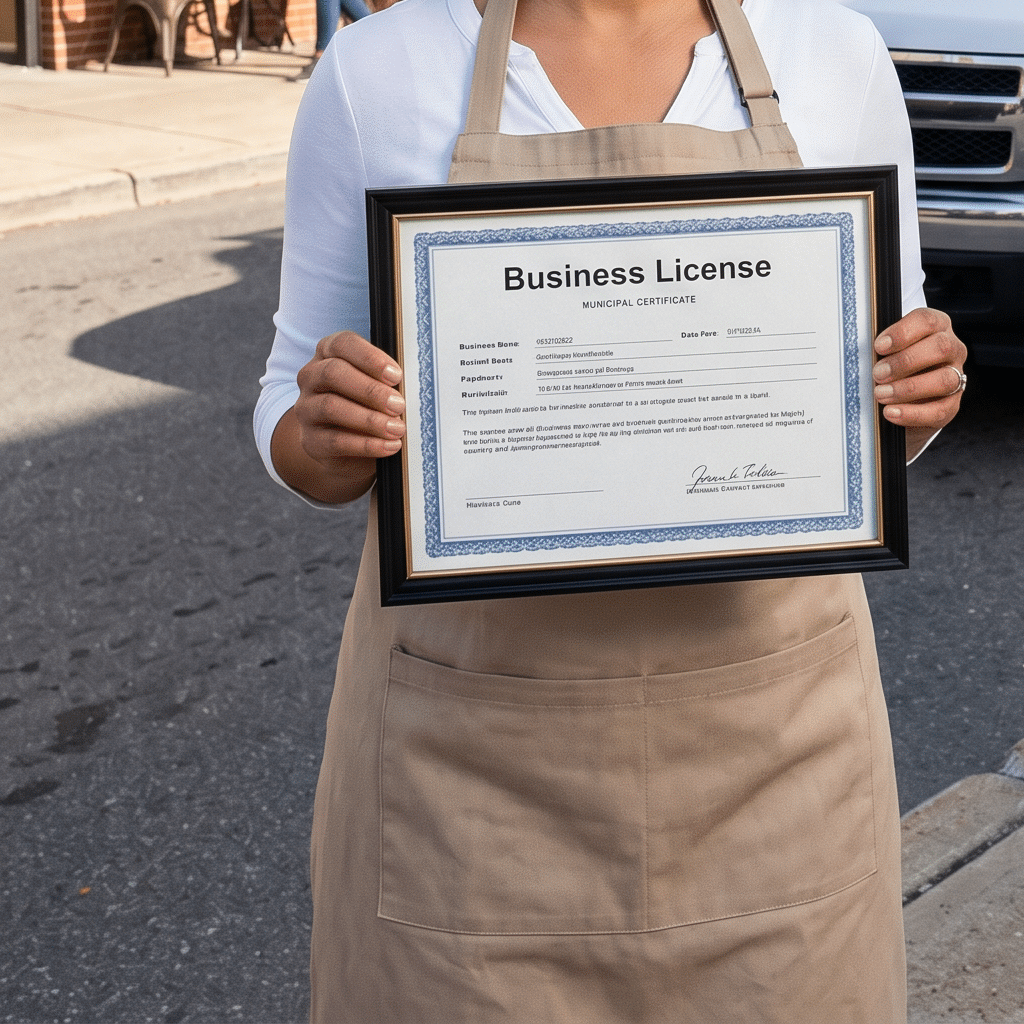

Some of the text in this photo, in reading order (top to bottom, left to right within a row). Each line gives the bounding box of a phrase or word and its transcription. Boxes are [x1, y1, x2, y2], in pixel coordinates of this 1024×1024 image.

[504, 258, 772, 291] Business License
[582, 295, 696, 309] MUNICIPAL CERTIFICATE
